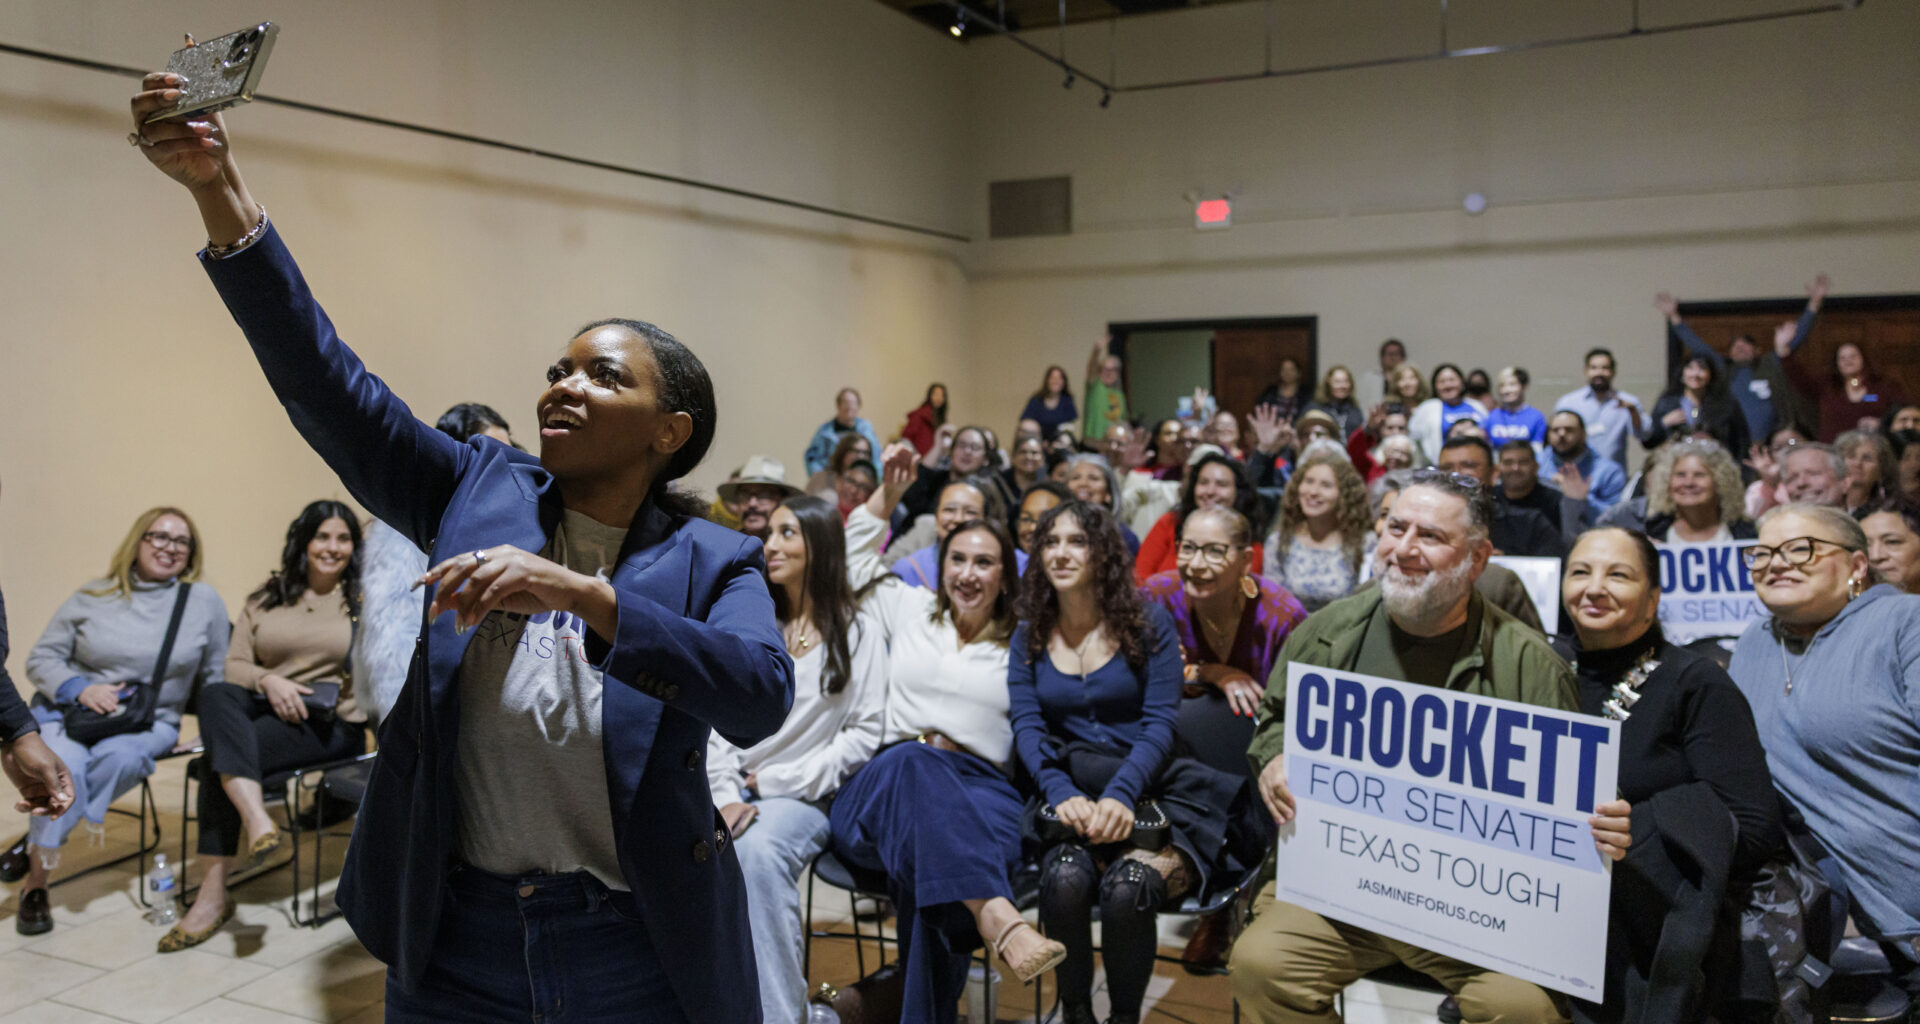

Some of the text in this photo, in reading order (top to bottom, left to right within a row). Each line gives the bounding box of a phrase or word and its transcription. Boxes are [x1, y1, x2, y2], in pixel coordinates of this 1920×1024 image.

[1659, 546, 1755, 594] OCKE
[476, 617, 555, 659] EXAS
[1683, 600, 1757, 621] SENA
[1295, 672, 1610, 814] CROCKETT
[1310, 763, 1578, 861] FOR SENATE
[1319, 819, 1560, 913] TEXAS TOUGH
[1357, 877, 1506, 933] JASMINEFORUS.COM
